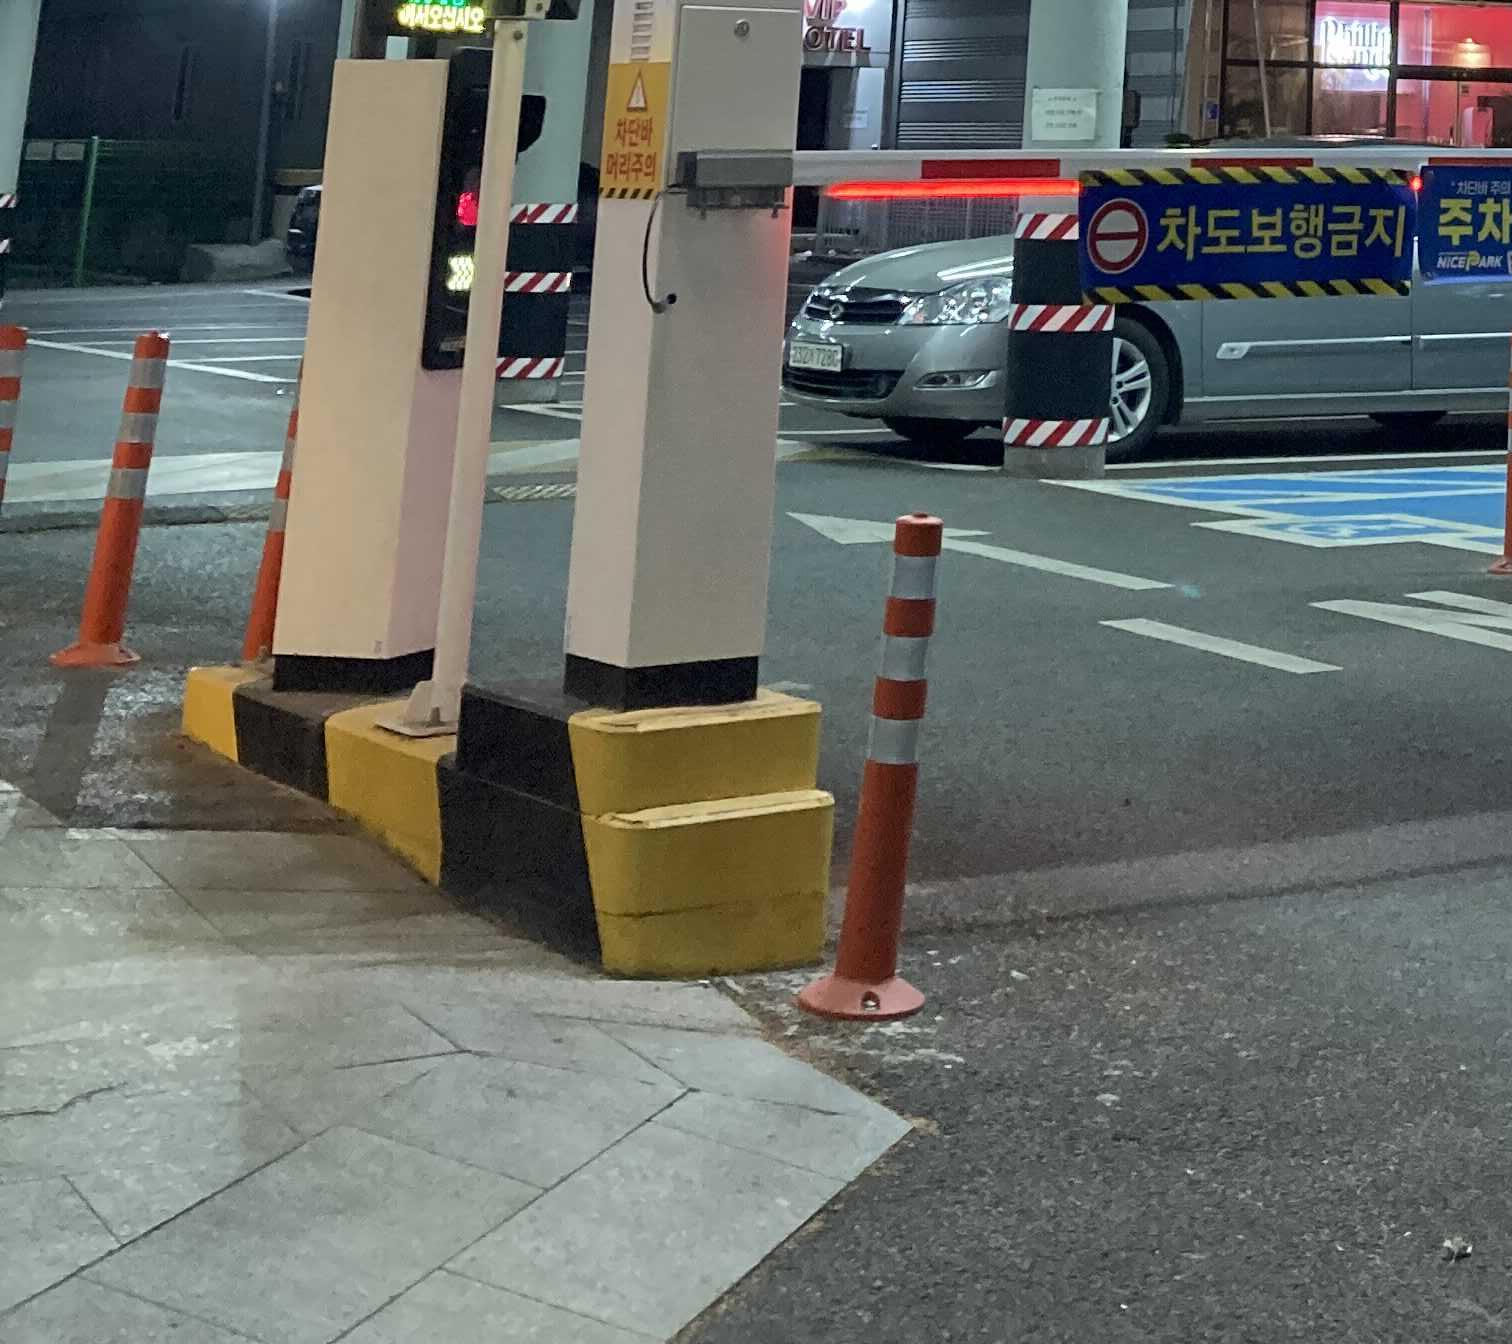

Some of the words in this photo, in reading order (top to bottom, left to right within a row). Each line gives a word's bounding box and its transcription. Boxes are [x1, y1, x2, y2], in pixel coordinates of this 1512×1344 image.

[803, 25, 872, 54] OTEL
[615, 117, 653, 147] 차단바
[605, 151, 657, 183] 머리주의
[1158, 203, 1407, 263] 차도보행금지
